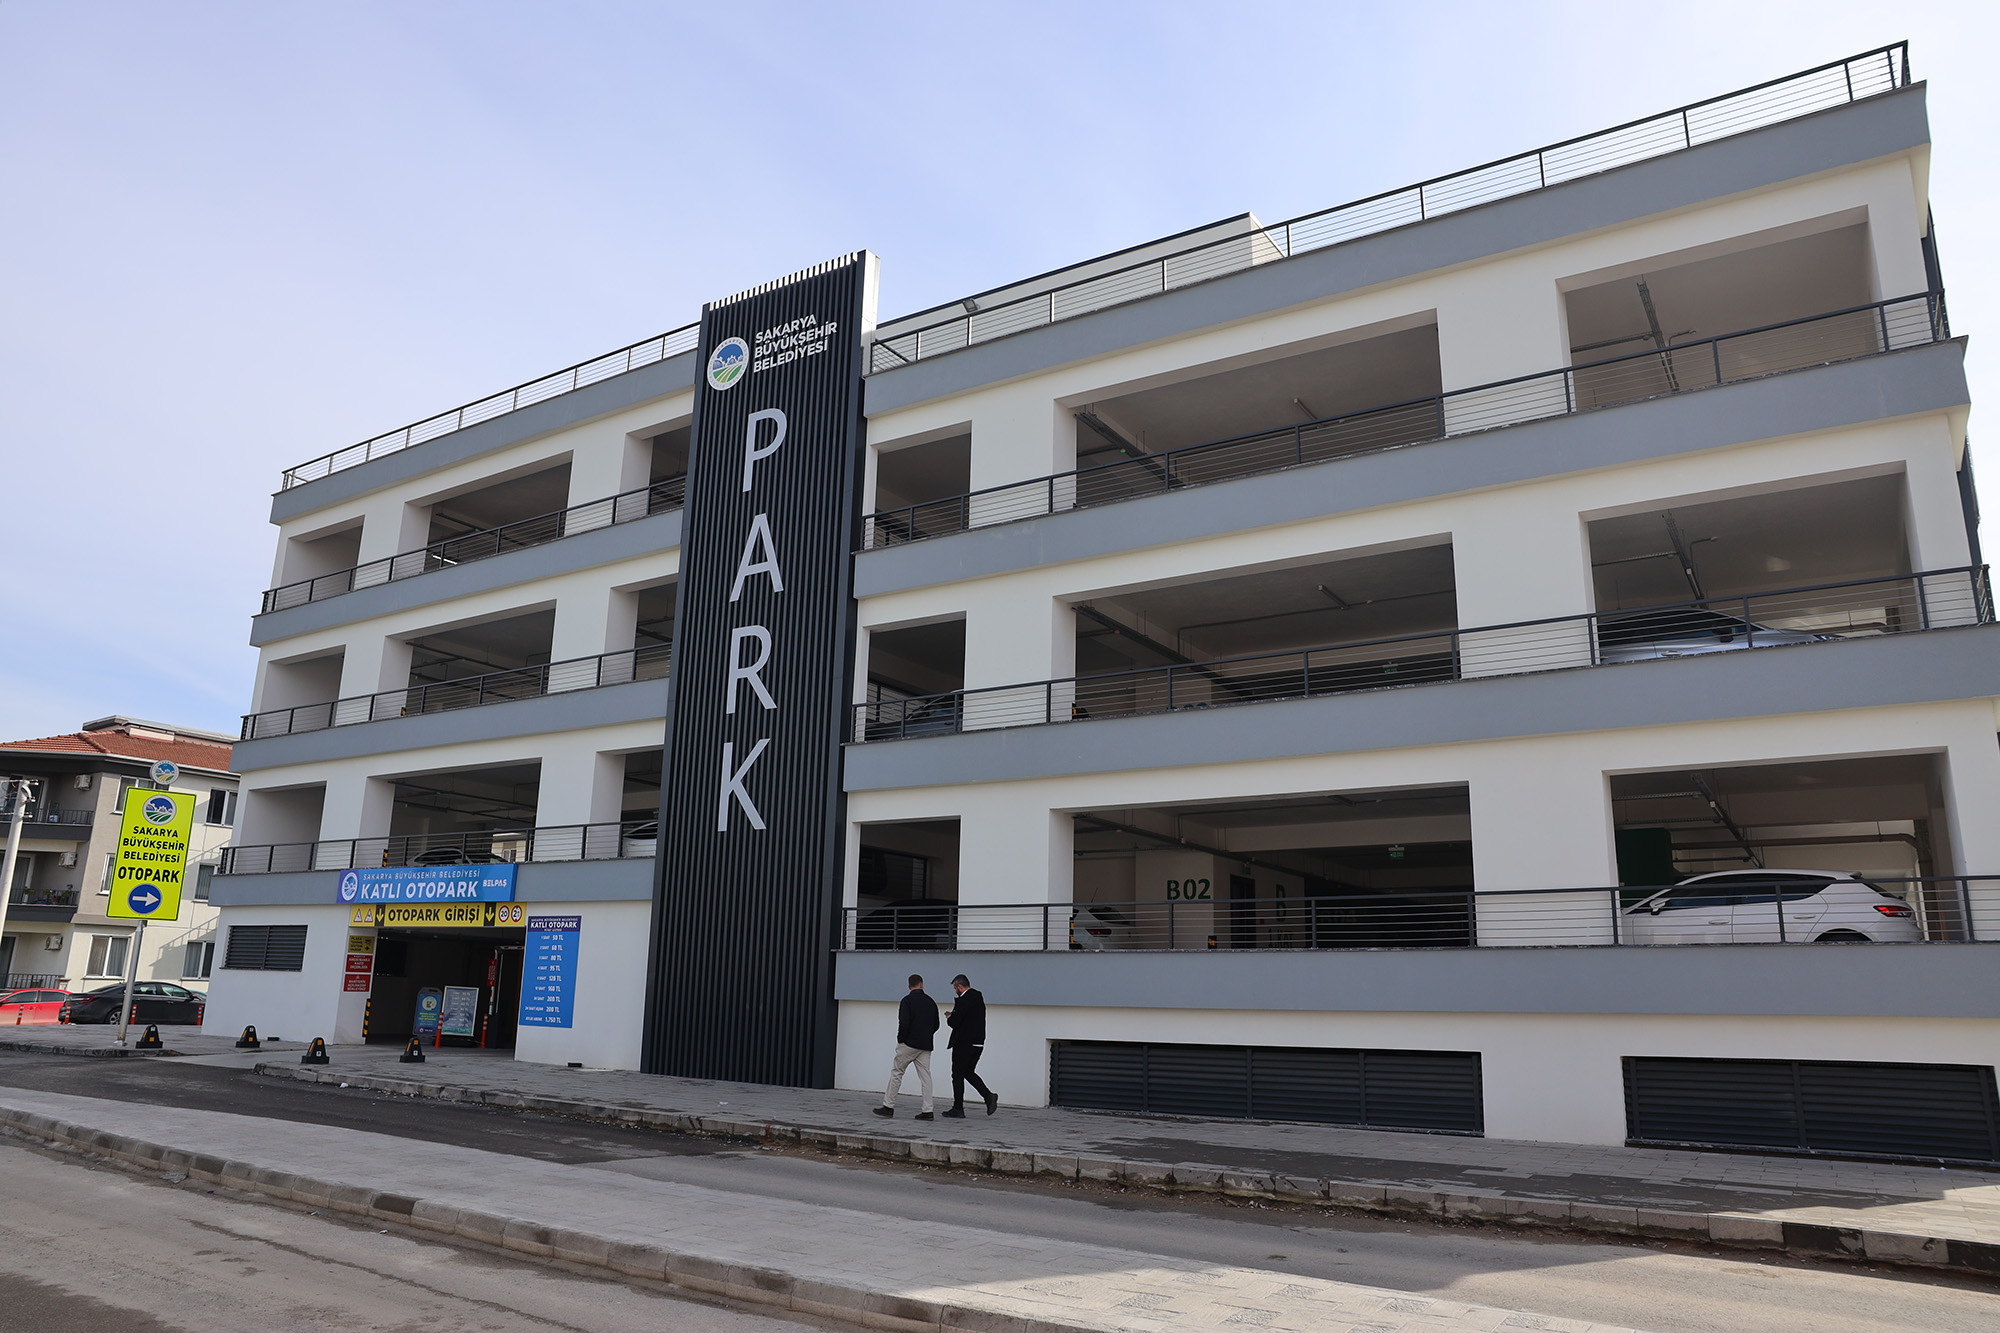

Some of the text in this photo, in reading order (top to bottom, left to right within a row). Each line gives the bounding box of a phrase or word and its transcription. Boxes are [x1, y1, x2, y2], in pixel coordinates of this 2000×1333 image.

[755, 314, 817, 344] SAKARYA
[754, 321, 838, 359] BÜYÜKŞEHİR
[753, 337, 829, 373] BELEDİYESİ
[717, 408, 788, 832] PARK
[133, 826, 178, 838] SAKARYA
[123, 837, 185, 851] BÜYÜKŞEHİR
[123, 851, 181, 863] BELEDİYESİ
[118, 866, 181, 883] OTOPARK
[395, 870, 437, 880] BÜYÜKŞEHİR
[439, 868, 480, 879] BELEDİYESİ
[361, 881, 479, 899] KATLI OTOPARK
[1167, 878, 1211, 900] B02
[388, 905, 480, 923] OTOPARK GİRİŞİ
